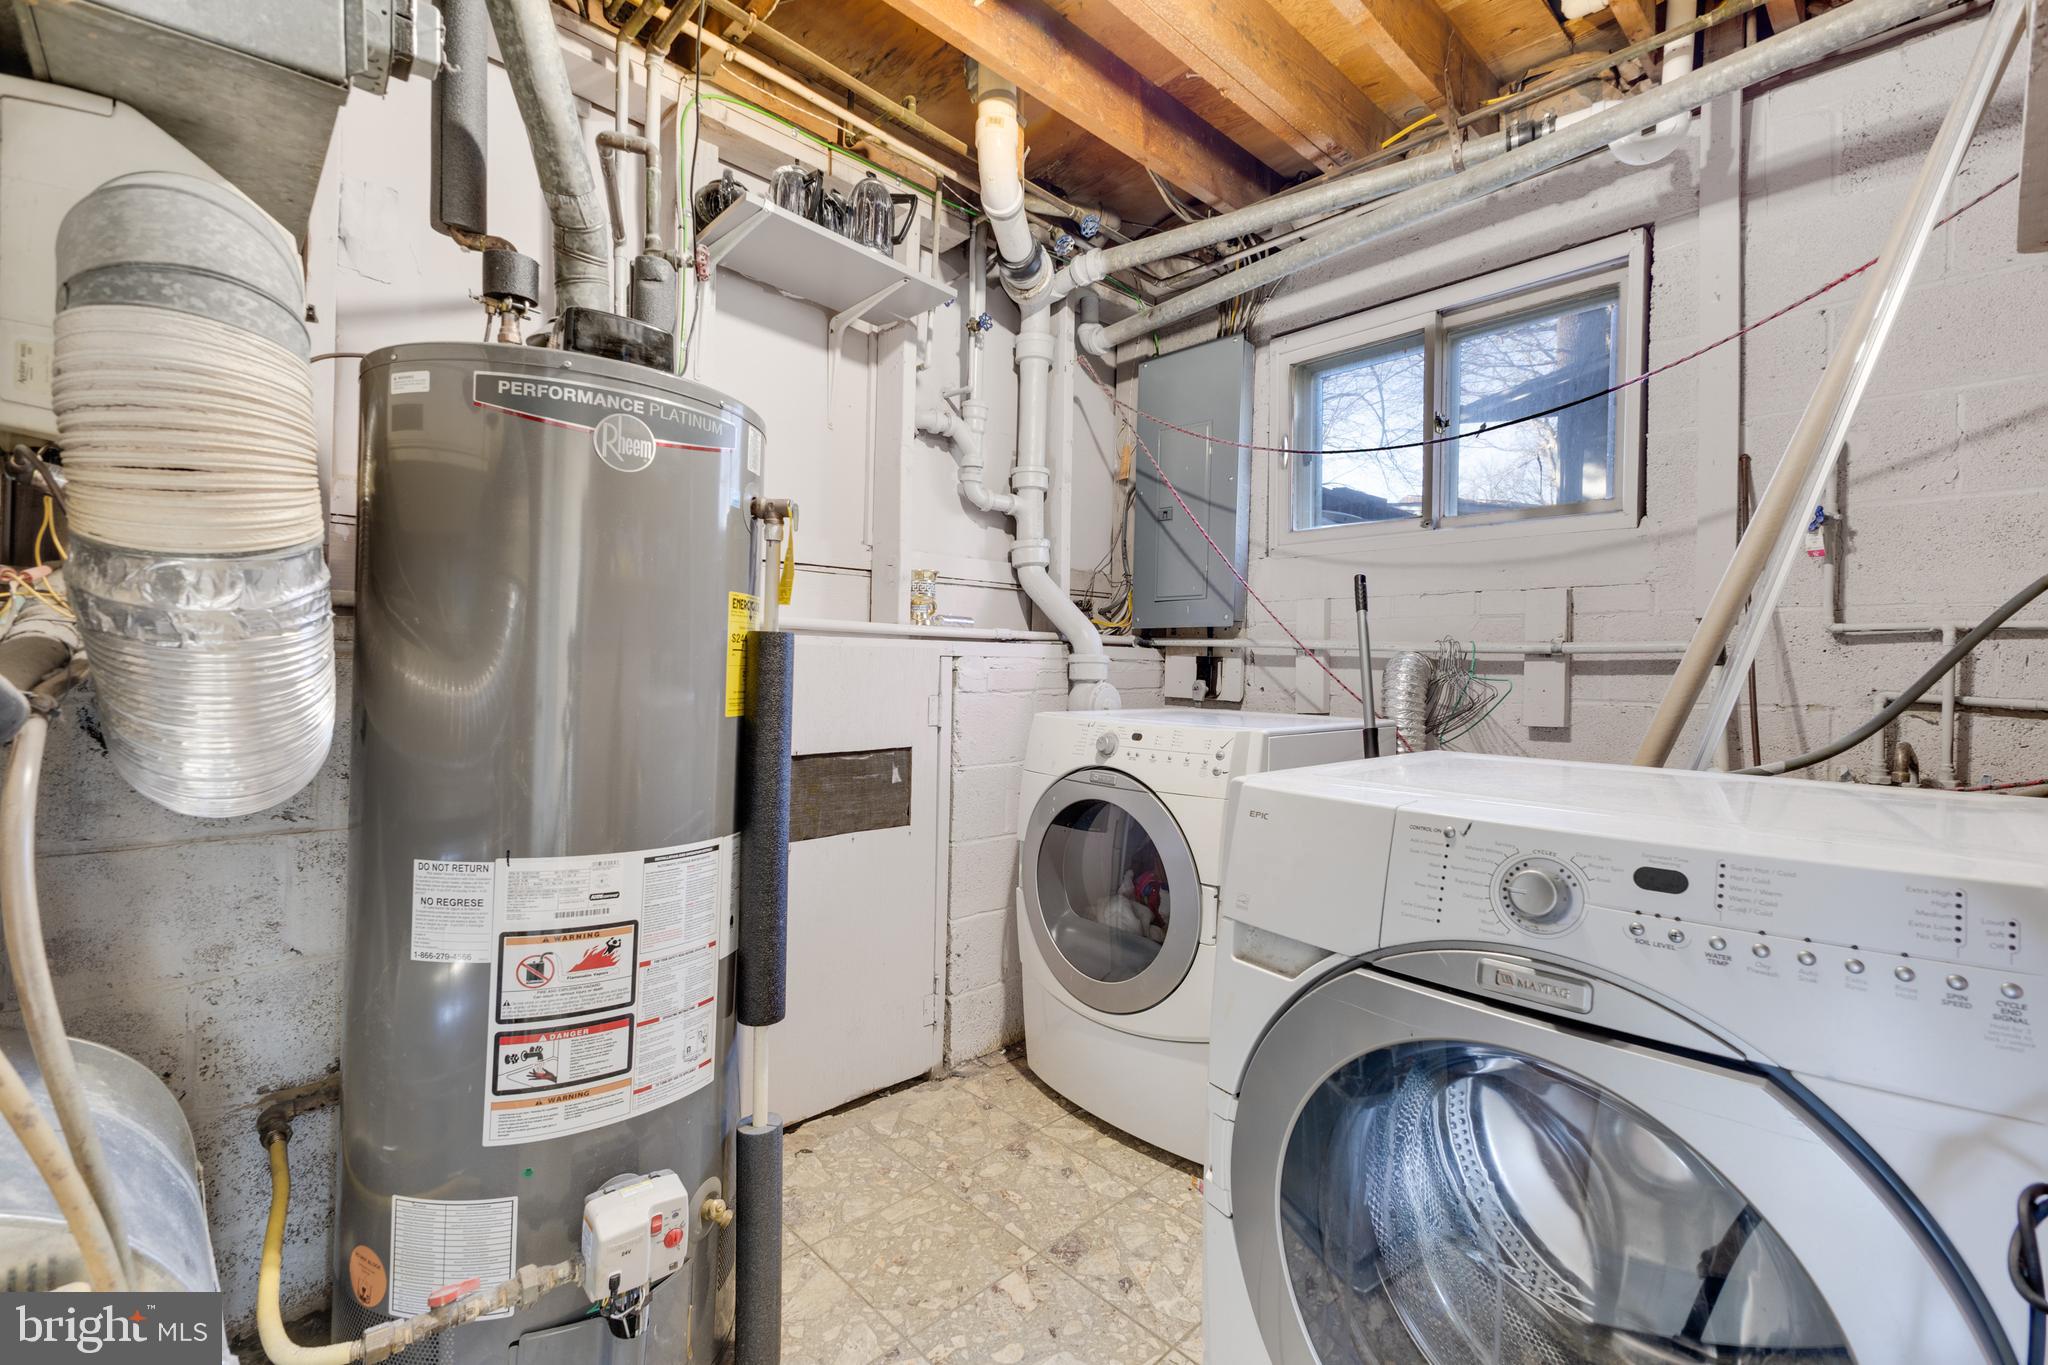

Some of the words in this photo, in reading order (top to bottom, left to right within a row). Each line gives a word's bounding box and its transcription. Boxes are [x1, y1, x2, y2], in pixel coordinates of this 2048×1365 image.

[498, 380, 644, 413] PERFORMANCE
[650, 402, 723, 436] PLATINUM
[602, 416, 652, 462] Rheem
[1249, 811, 1269, 820] EPIC
[1532, 849, 1557, 857] CYCLES
[418, 862, 431, 871] DO
[432, 863, 450, 872] NOT
[452, 864, 490, 873] RETURN
[1752, 876, 1771, 885] Cold
[1729, 883, 1752, 893] Warm
[1759, 887, 1783, 897] Warm
[420, 897, 434, 906] NO
[436, 897, 484, 907] REGRESE
[1729, 893, 1751, 903] Warm
[1758, 898, 1778, 907] Cold
[1727, 905, 1747, 913] Cold
[1754, 907, 1774, 917] Cold
[554, 931, 601, 942] WARNING
[1635, 937, 1650, 946] SOIL
[1653, 941, 1676, 951] LEVEL
[1705, 951, 1732, 962] WATER
[1708, 958, 1730, 967] TEMP
[1517, 979, 1571, 1000] MAYTAG
[1946, 992, 1969, 1002] SPIN
[1941, 999, 1973, 1010] SPEED
[1995, 999, 2028, 1011] CYCLE
[2000, 1007, 2023, 1017] END
[1992, 1013, 2031, 1026] SIGNAL
[549, 1028, 589, 1041] DANGER
[547, 1090, 591, 1104] WARNING
